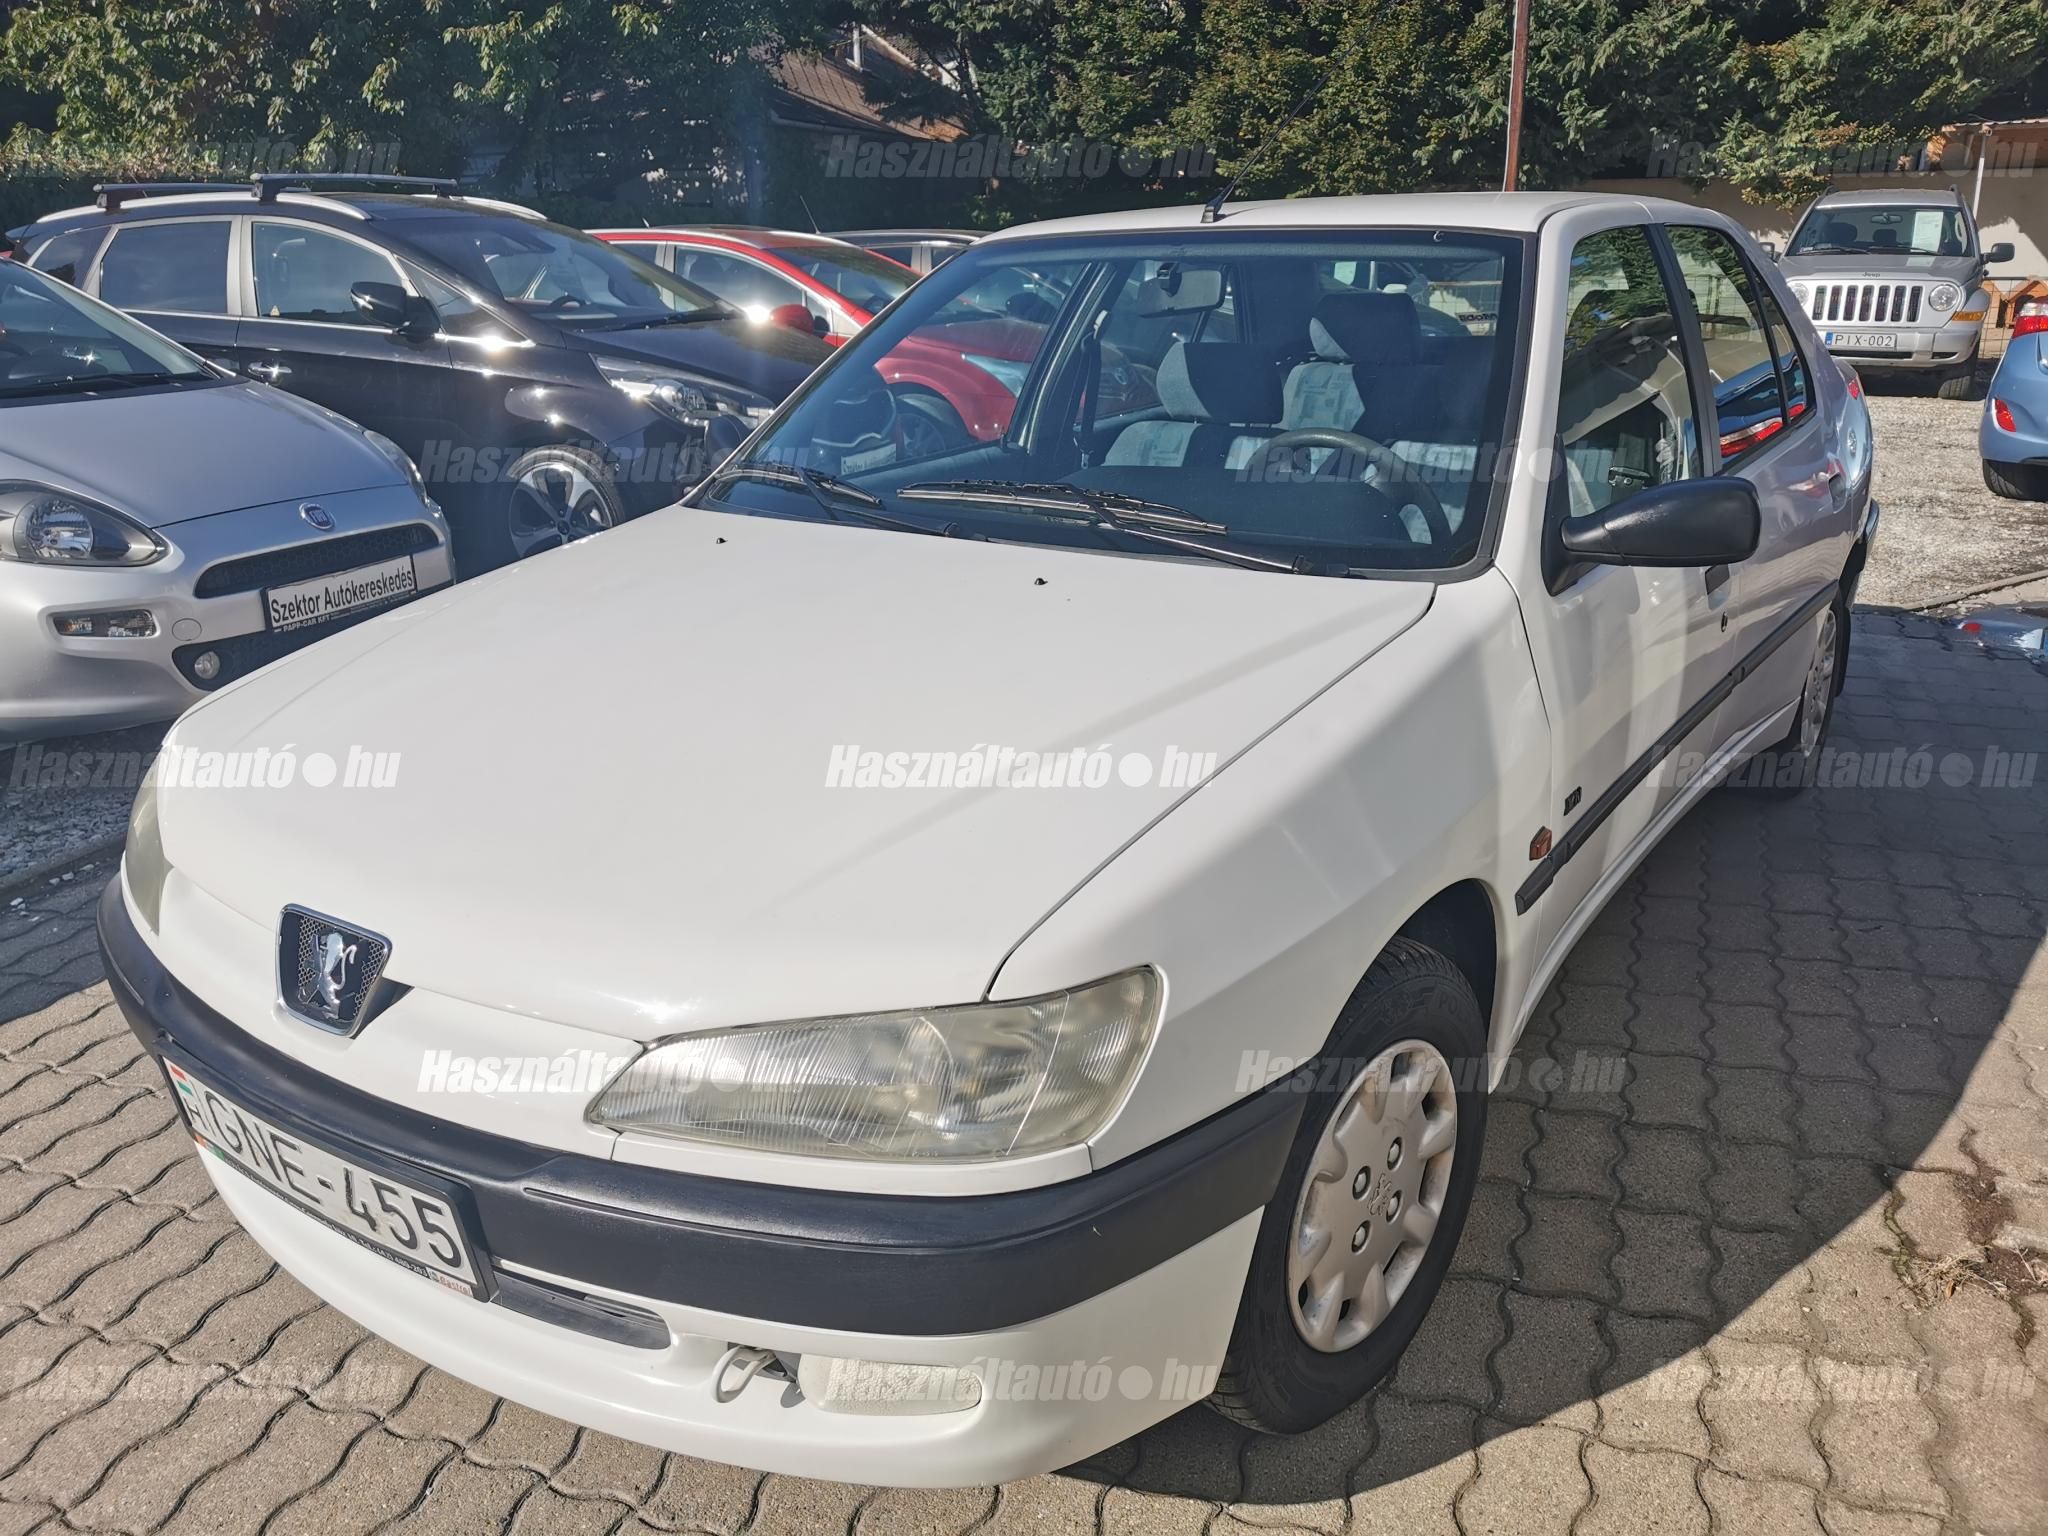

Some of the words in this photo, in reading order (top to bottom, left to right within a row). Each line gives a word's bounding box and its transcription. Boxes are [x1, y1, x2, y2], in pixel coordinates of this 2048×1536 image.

[1835, 334, 1892, 347] PIX-002
[271, 592, 320, 623] Szektor
[324, 566, 413, 611] Autókereskedés
[283, 617, 317, 632] PAPP-CAR
[183, 1096, 209, 1131] H
[205, 1090, 461, 1268] GNE-455
